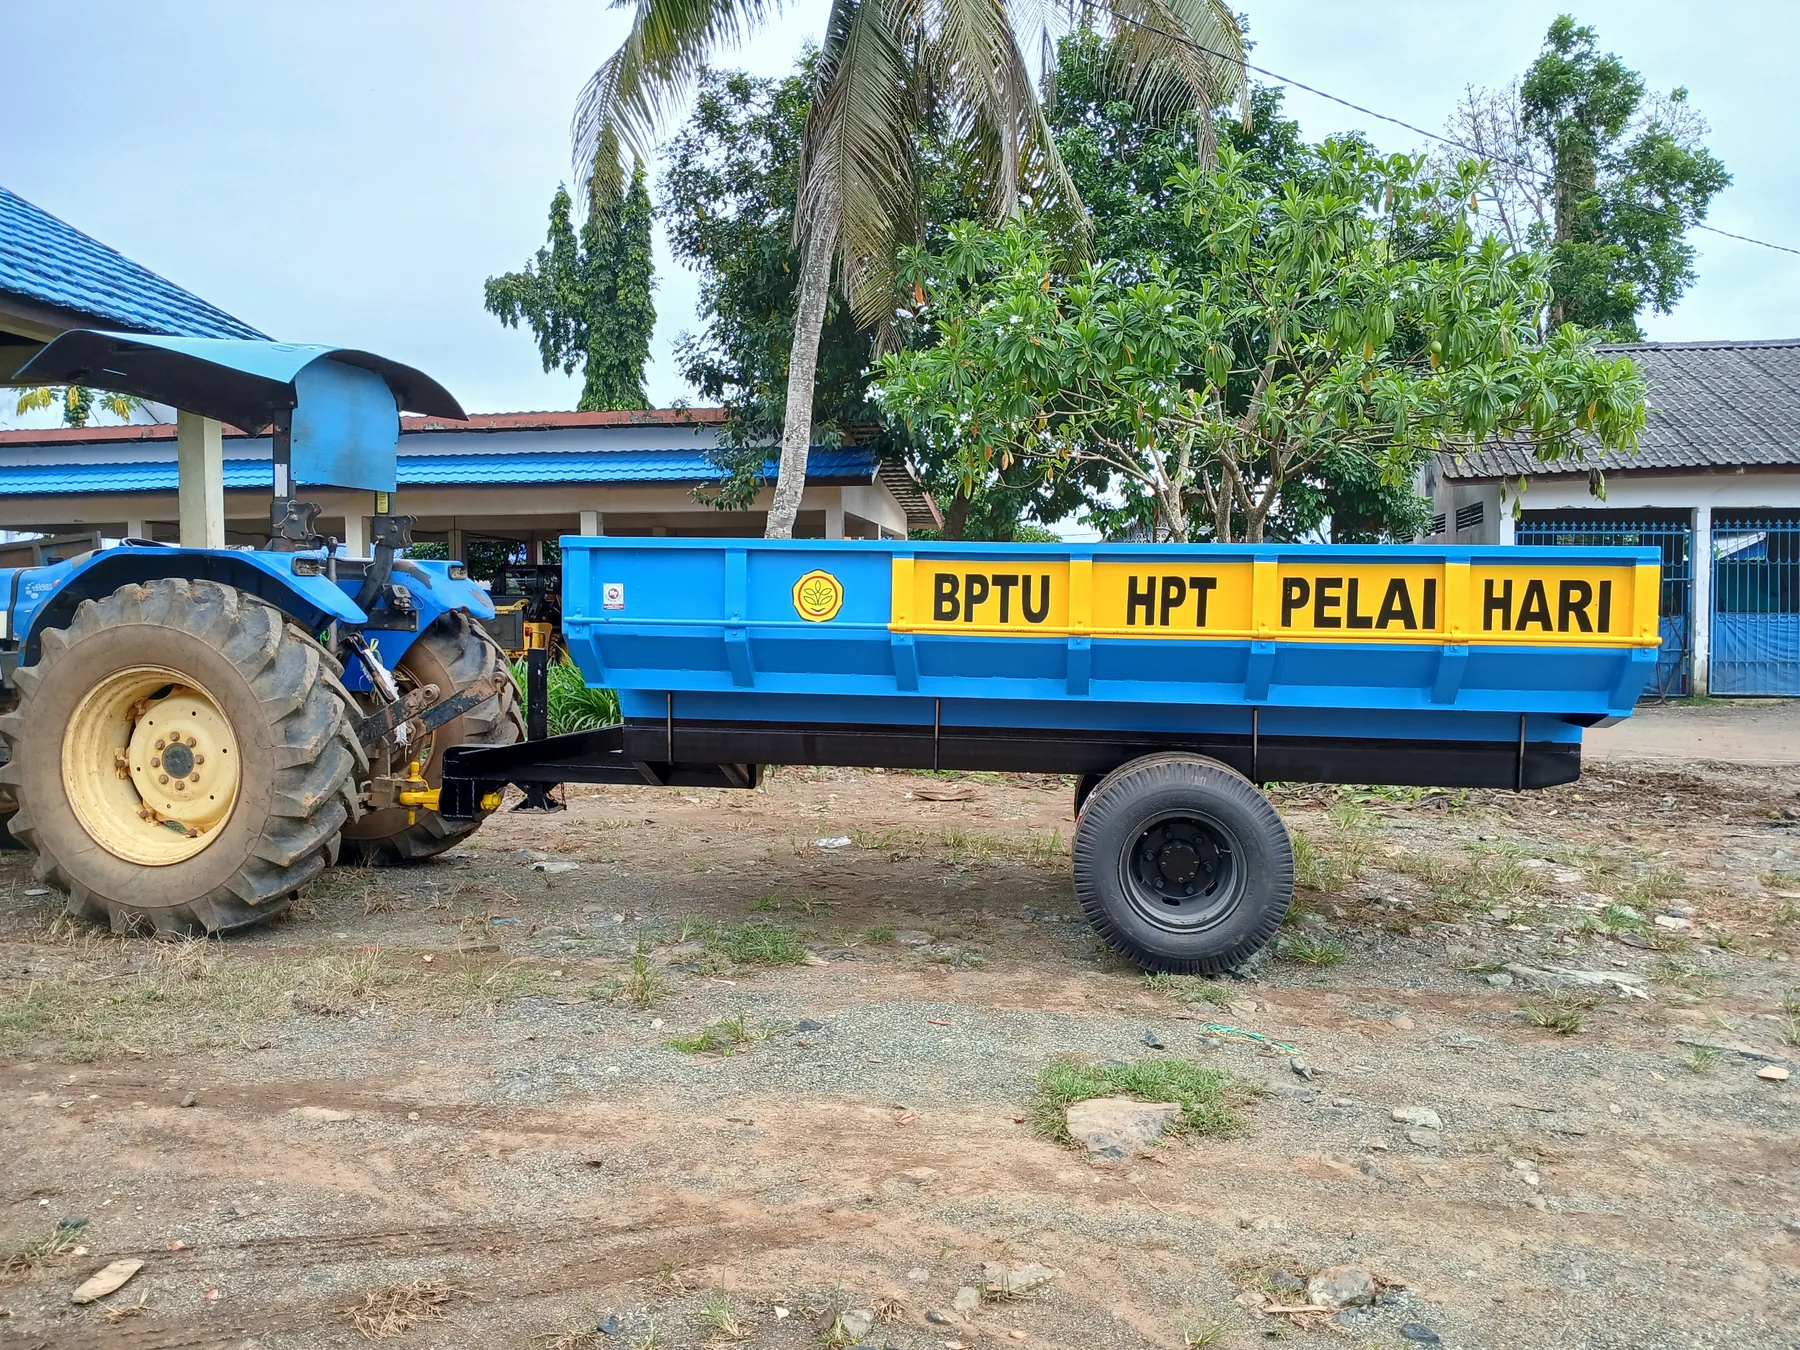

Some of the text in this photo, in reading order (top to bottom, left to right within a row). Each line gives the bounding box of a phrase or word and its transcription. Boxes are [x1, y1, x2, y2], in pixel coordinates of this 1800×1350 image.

[933, 573, 1612, 633] BPTU HPT PELAI HARI
